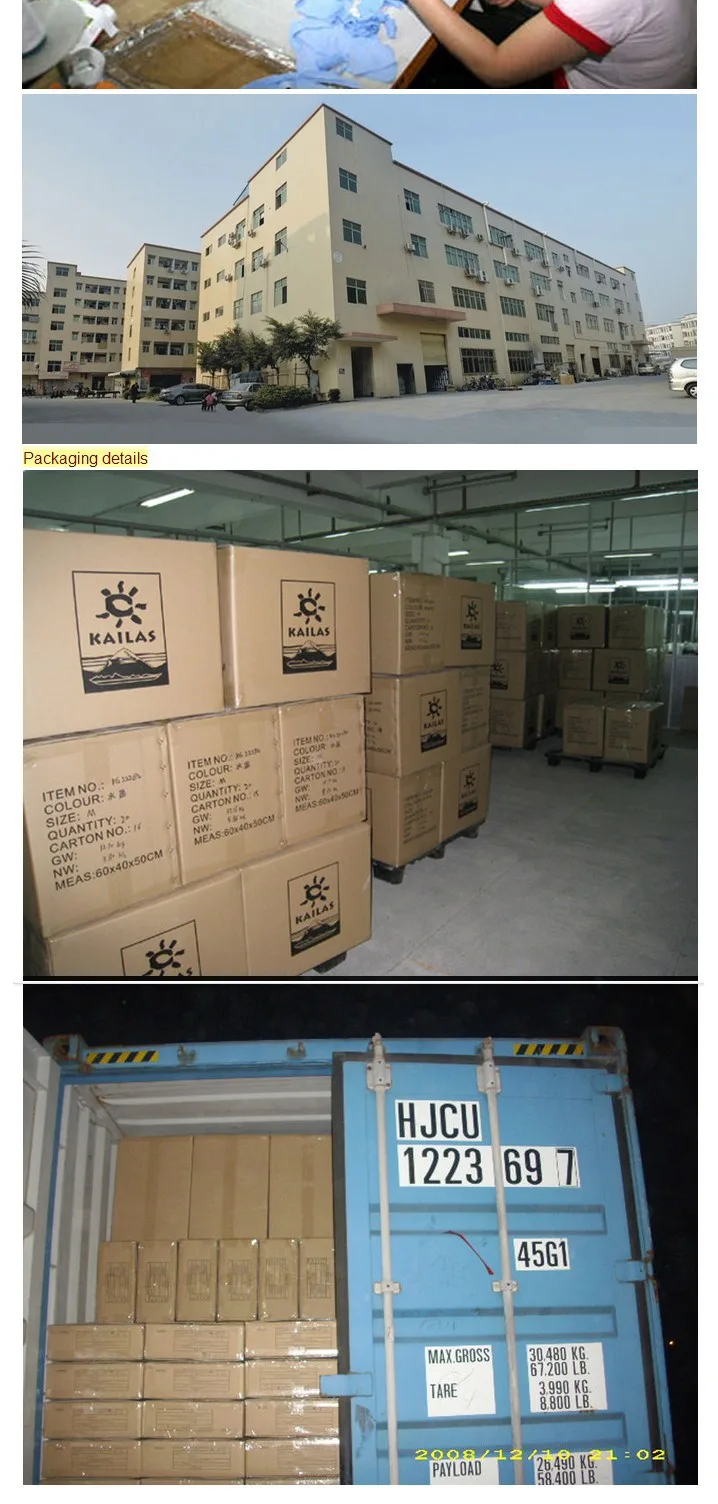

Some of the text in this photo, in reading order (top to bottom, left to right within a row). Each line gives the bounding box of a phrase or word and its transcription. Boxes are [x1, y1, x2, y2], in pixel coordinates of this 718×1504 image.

[89, 630, 156, 646] KAILAS
[288, 626, 331, 638] KAILAS
[187, 757, 212, 770] ITEM
[188, 764, 233, 781] COLOUR:
[189, 779, 215, 792] SIZE:
[190, 783, 241, 803] QUANTITY:
[42, 786, 75, 802] ITEM
[44, 794, 105, 815] COLOUR:
[191, 797, 231, 814] CARTON
[46, 813, 80, 828] SIZE:
[192, 813, 212, 825] GW:
[47, 816, 117, 841] QUANTITY:
[193, 823, 213, 835] NW:
[49, 832, 104, 854] CARTON
[51, 851, 78, 866] GW:
[53, 864, 79, 878] NW:
[55, 849, 164, 891] MEAS:60x40x50CM
[295, 901, 335, 925] KAILAS
[398, 1102, 480, 1139] HJCU
[403, 1147, 574, 1186] 1223 69 7
[517, 1241, 569, 1268] 45G1
[571, 1346, 589, 1361] KG.
[573, 1361, 590, 1375] LB.
[430, 1383, 458, 1399] TARE
[574, 1379, 592, 1394] KG.
[575, 1394, 594, 1409] LB.
[433, 1460, 482, 1477] PAYLOAD
[581, 1469, 599, 1484] LB.
